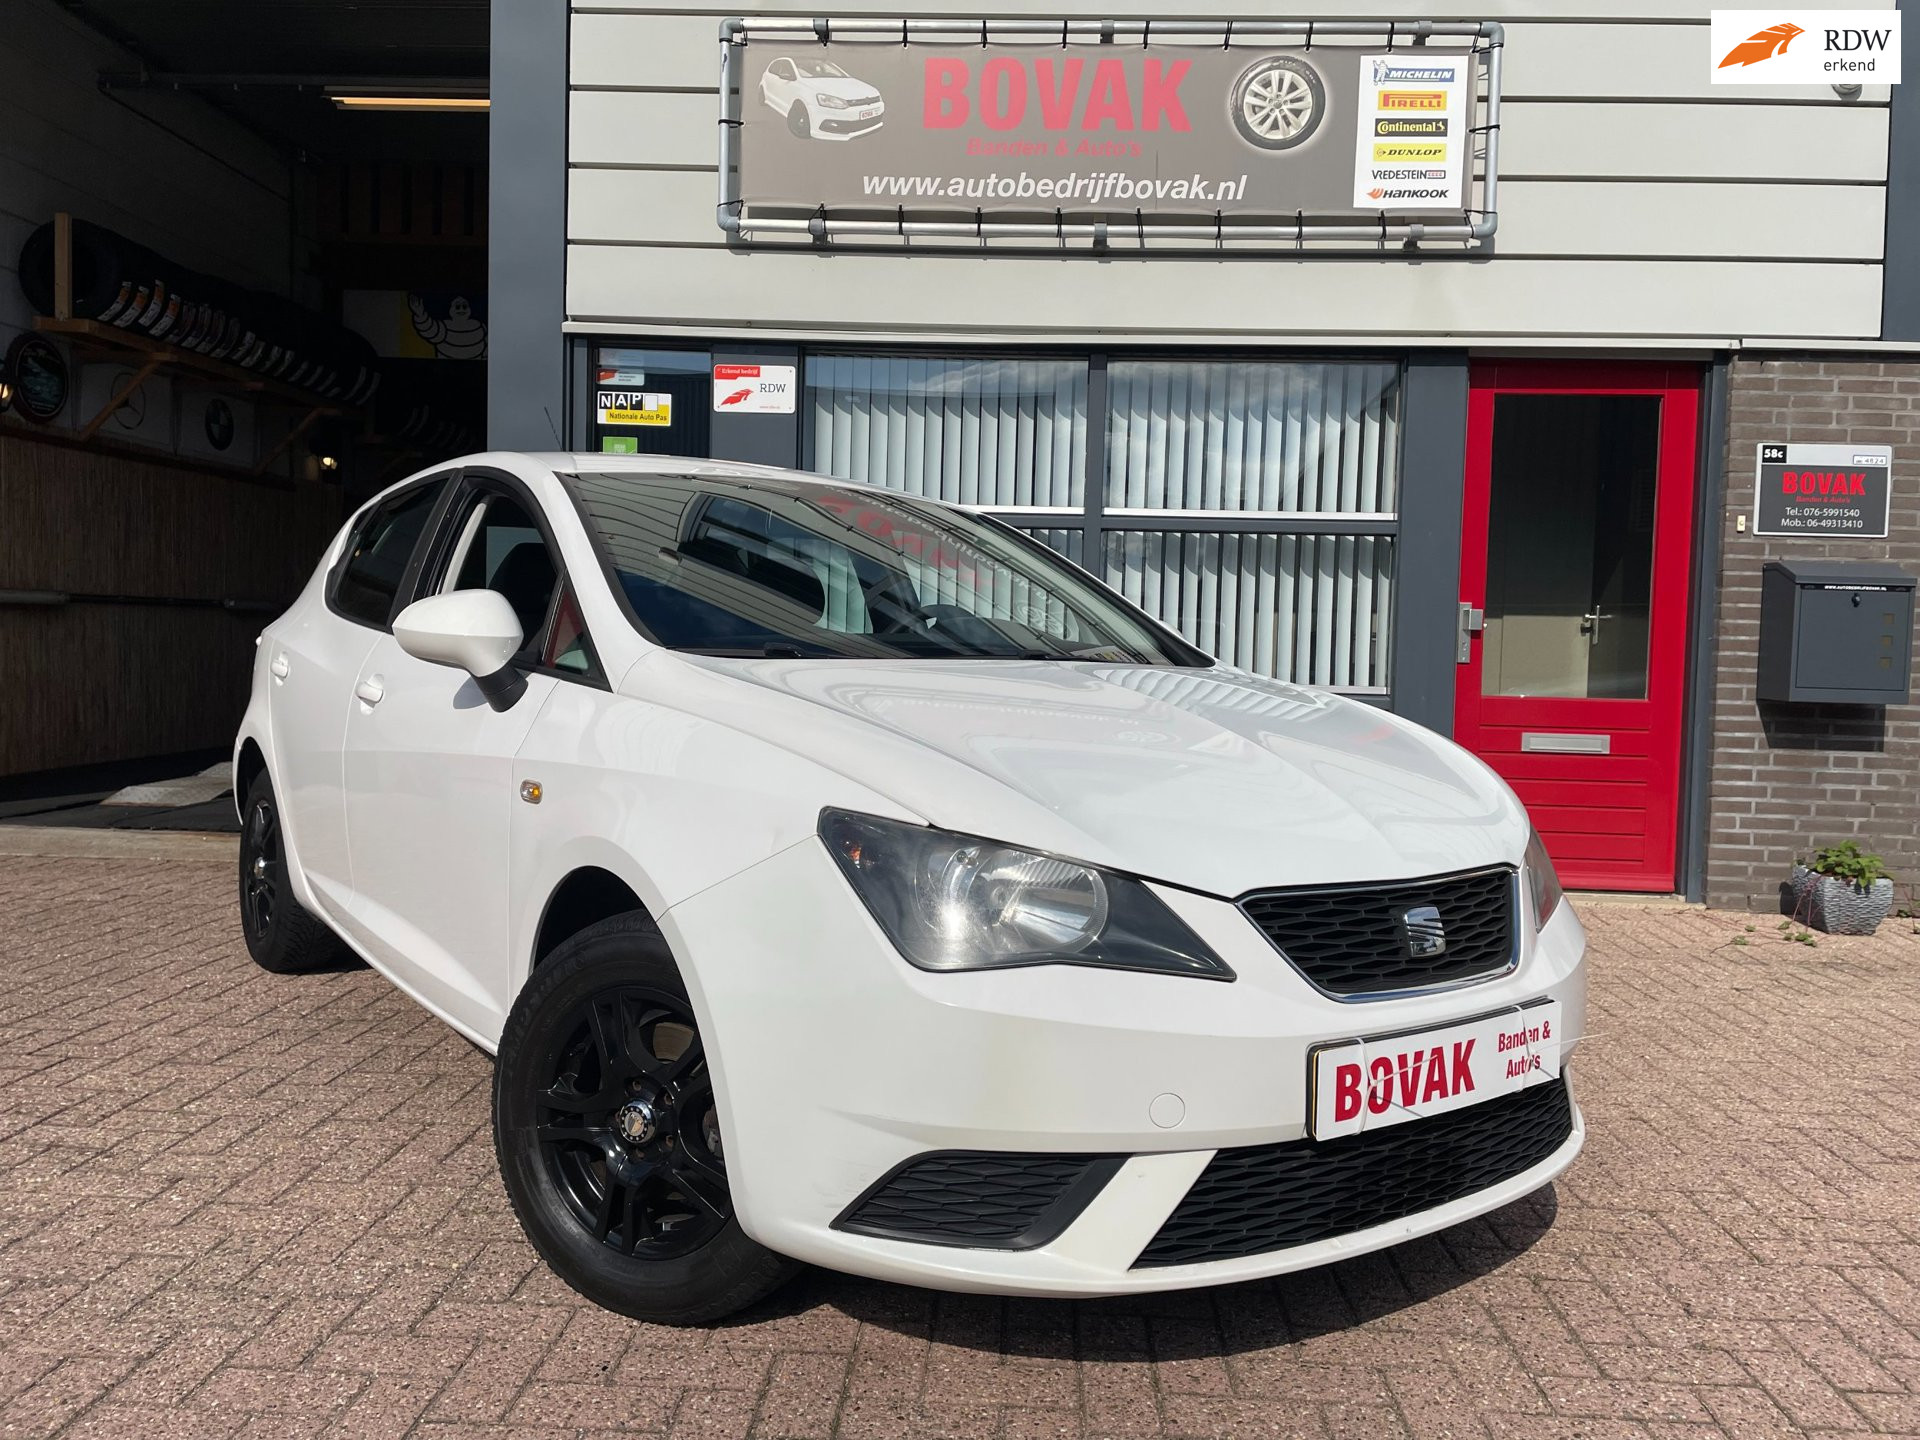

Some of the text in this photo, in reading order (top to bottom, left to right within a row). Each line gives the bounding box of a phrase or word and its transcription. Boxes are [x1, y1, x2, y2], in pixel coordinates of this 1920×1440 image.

[1389, 69, 1453, 79] MICHELIN
[923, 57, 1193, 132] BOVAK
[1383, 94, 1442, 107] PIRELLI
[1377, 121, 1436, 134] Continental
[966, 136, 1143, 158] Banden & Auto's
[1372, 170, 1428, 180] VREDESTEIN
[863, 172, 1248, 204] www.autobedrijfbovak.nl
[760, 384, 786, 393] RDW
[600, 394, 642, 407] NAP
[609, 412, 638, 420] Nationale
[1764, 449, 1784, 458] 58c
[1782, 471, 1866, 496] BOVAK
[1785, 507, 1860, 517] Tel.: 076-5991540
[1781, 518, 1863, 528] Mob.: 06-49313410
[1498, 1020, 1551, 1053] Banden &
[1505, 1054, 1541, 1079] Auto's
[1335, 1038, 1477, 1123] BOVAK
